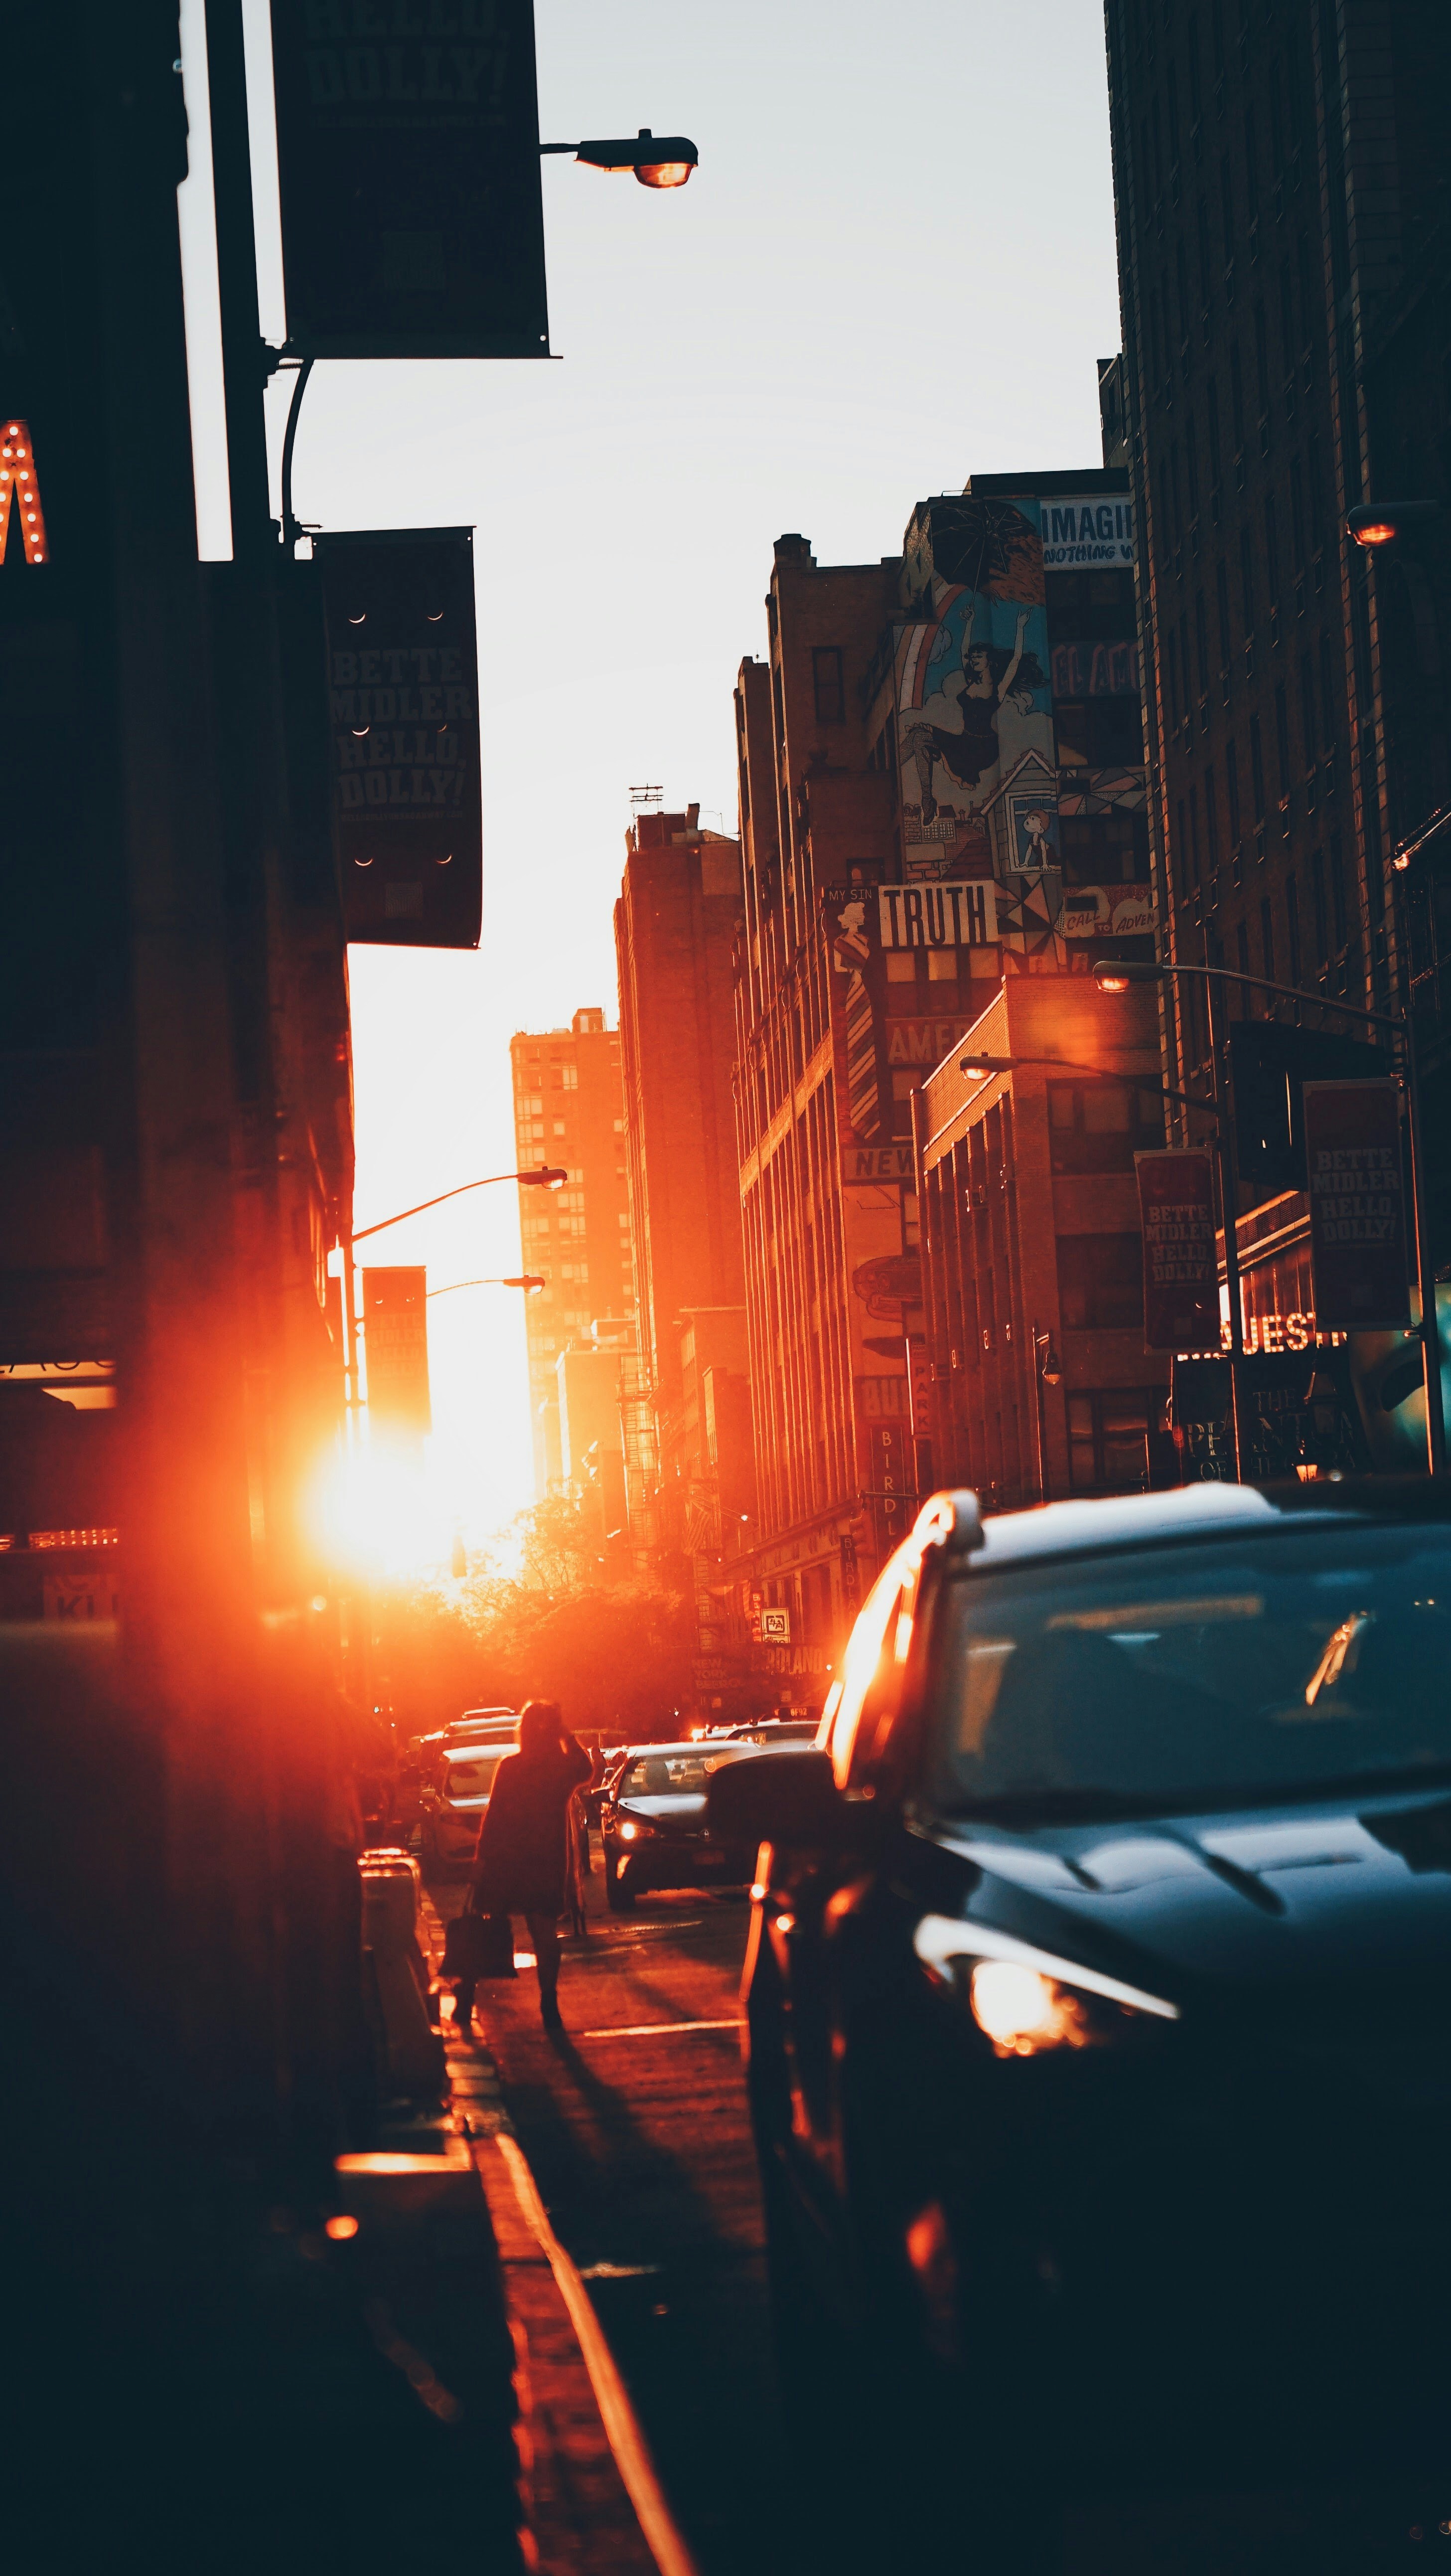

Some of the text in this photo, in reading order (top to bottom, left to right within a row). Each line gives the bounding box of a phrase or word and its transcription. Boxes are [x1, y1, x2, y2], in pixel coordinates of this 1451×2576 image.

[303, 45, 510, 105] DOLLY!
[1044, 544, 1116, 564] NOTHING
[332, 647, 462, 685] BETTE
[328, 685, 473, 723] MIDLER
[336, 730, 467, 771] HELLO,
[338, 769, 466, 808] DOLLY!
[829, 889, 872, 901] MY SIN
[883, 886, 987, 947] TRUTH
[1067, 910, 1100, 930] CALL
[1316, 1147, 1393, 1171] BETTE
[1312, 1170, 1400, 1193] MIDLER
[1148, 1204, 1208, 1223] BETTE
[1320, 1196, 1397, 1220] HELLO,
[1145, 1222, 1213, 1241] MIDLER
[1320, 1218, 1396, 1243] DOLLY!
[1152, 1244, 1211, 1263] HELLO,
[1152, 1263, 1210, 1282] DOLLY!
[915, 1366, 930, 1426] PARK
[691, 1658, 722, 1668] NEW
